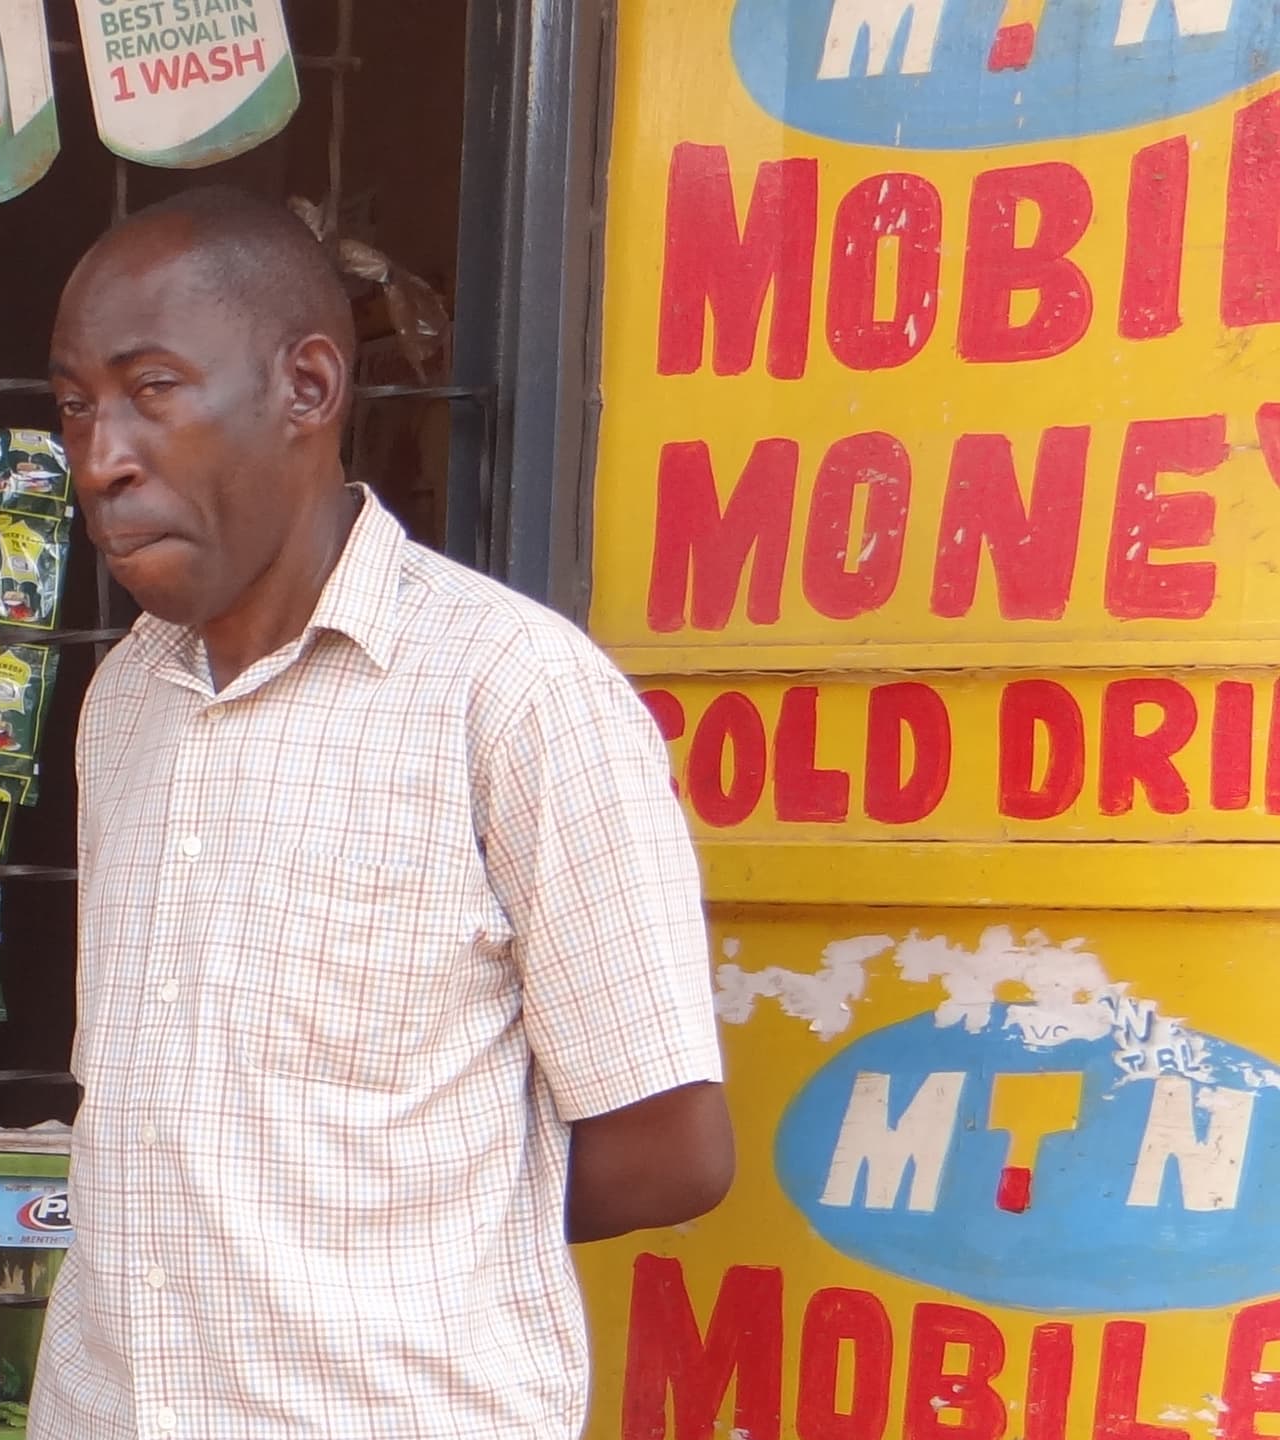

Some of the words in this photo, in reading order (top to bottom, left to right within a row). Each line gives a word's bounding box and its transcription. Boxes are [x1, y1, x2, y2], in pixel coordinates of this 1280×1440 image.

[100, 1, 165, 38] BEST
[105, 20, 227, 63] REMOVAL
[231, 12, 259, 38] IN
[109, 66, 136, 102] 1
[997, 677, 1280, 820] DRI
[818, 1070, 1258, 1214] MTN
[37, 1198, 74, 1221] P.
